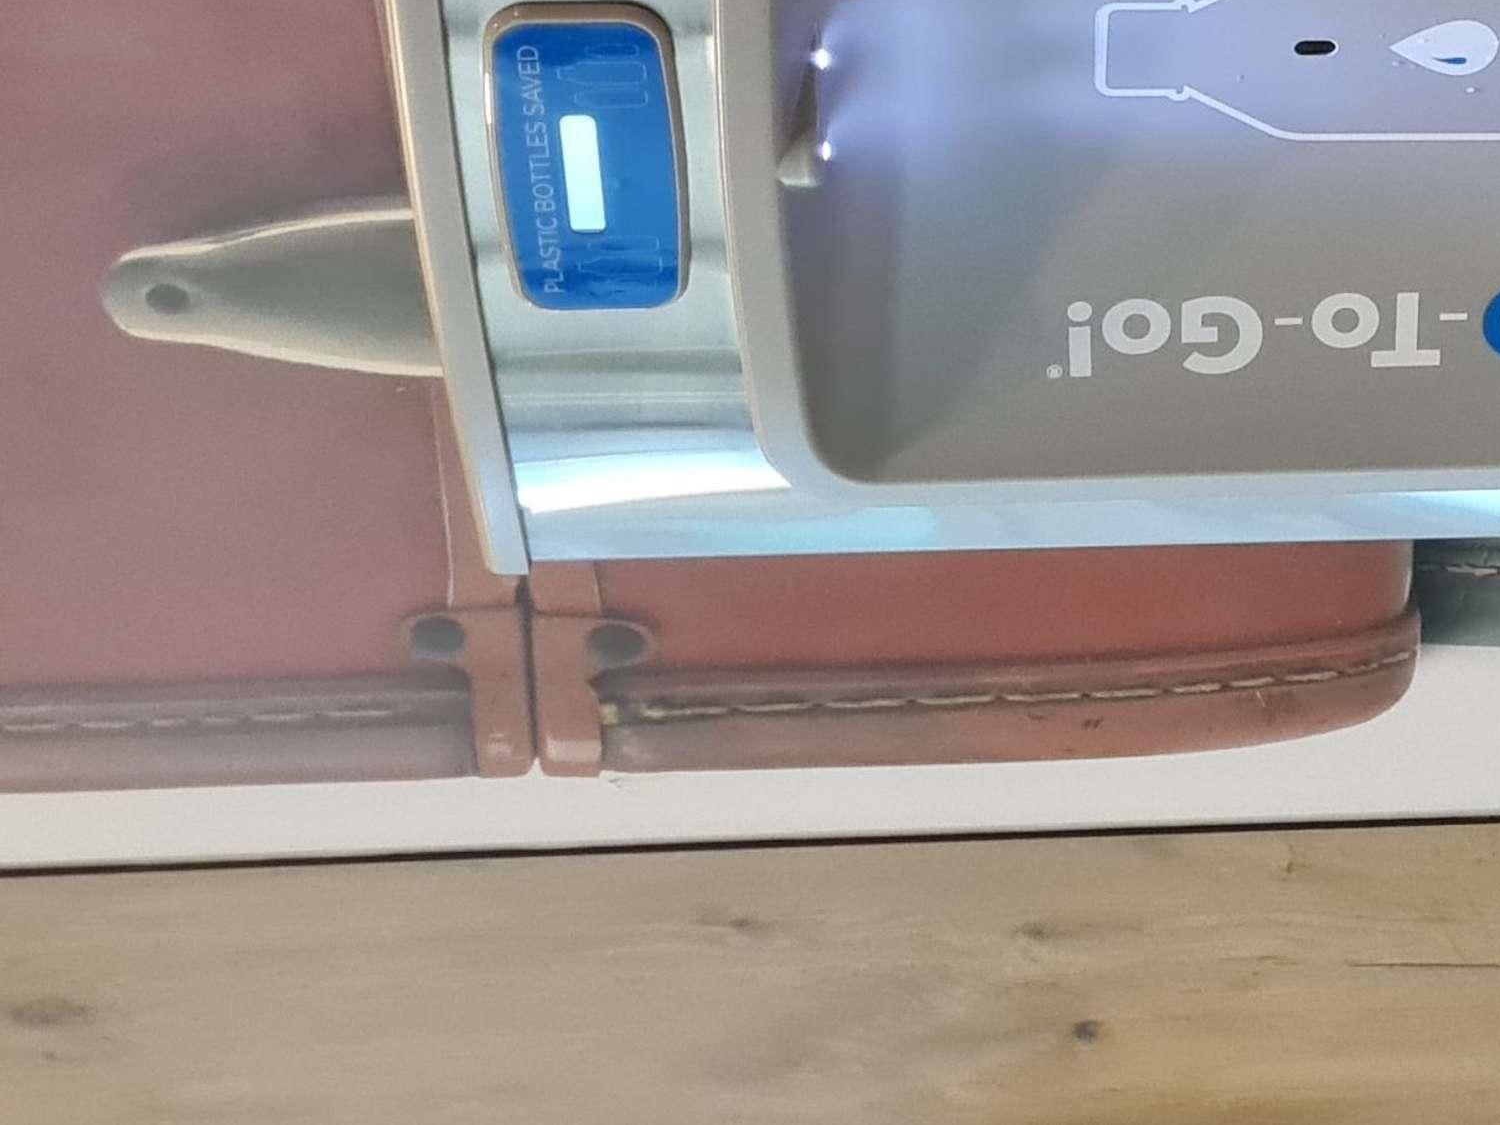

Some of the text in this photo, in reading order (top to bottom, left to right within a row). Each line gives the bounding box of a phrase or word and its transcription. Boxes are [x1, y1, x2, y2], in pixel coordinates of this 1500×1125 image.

[517, 44, 564, 294] PLASTIC BOTTLES SAVED
